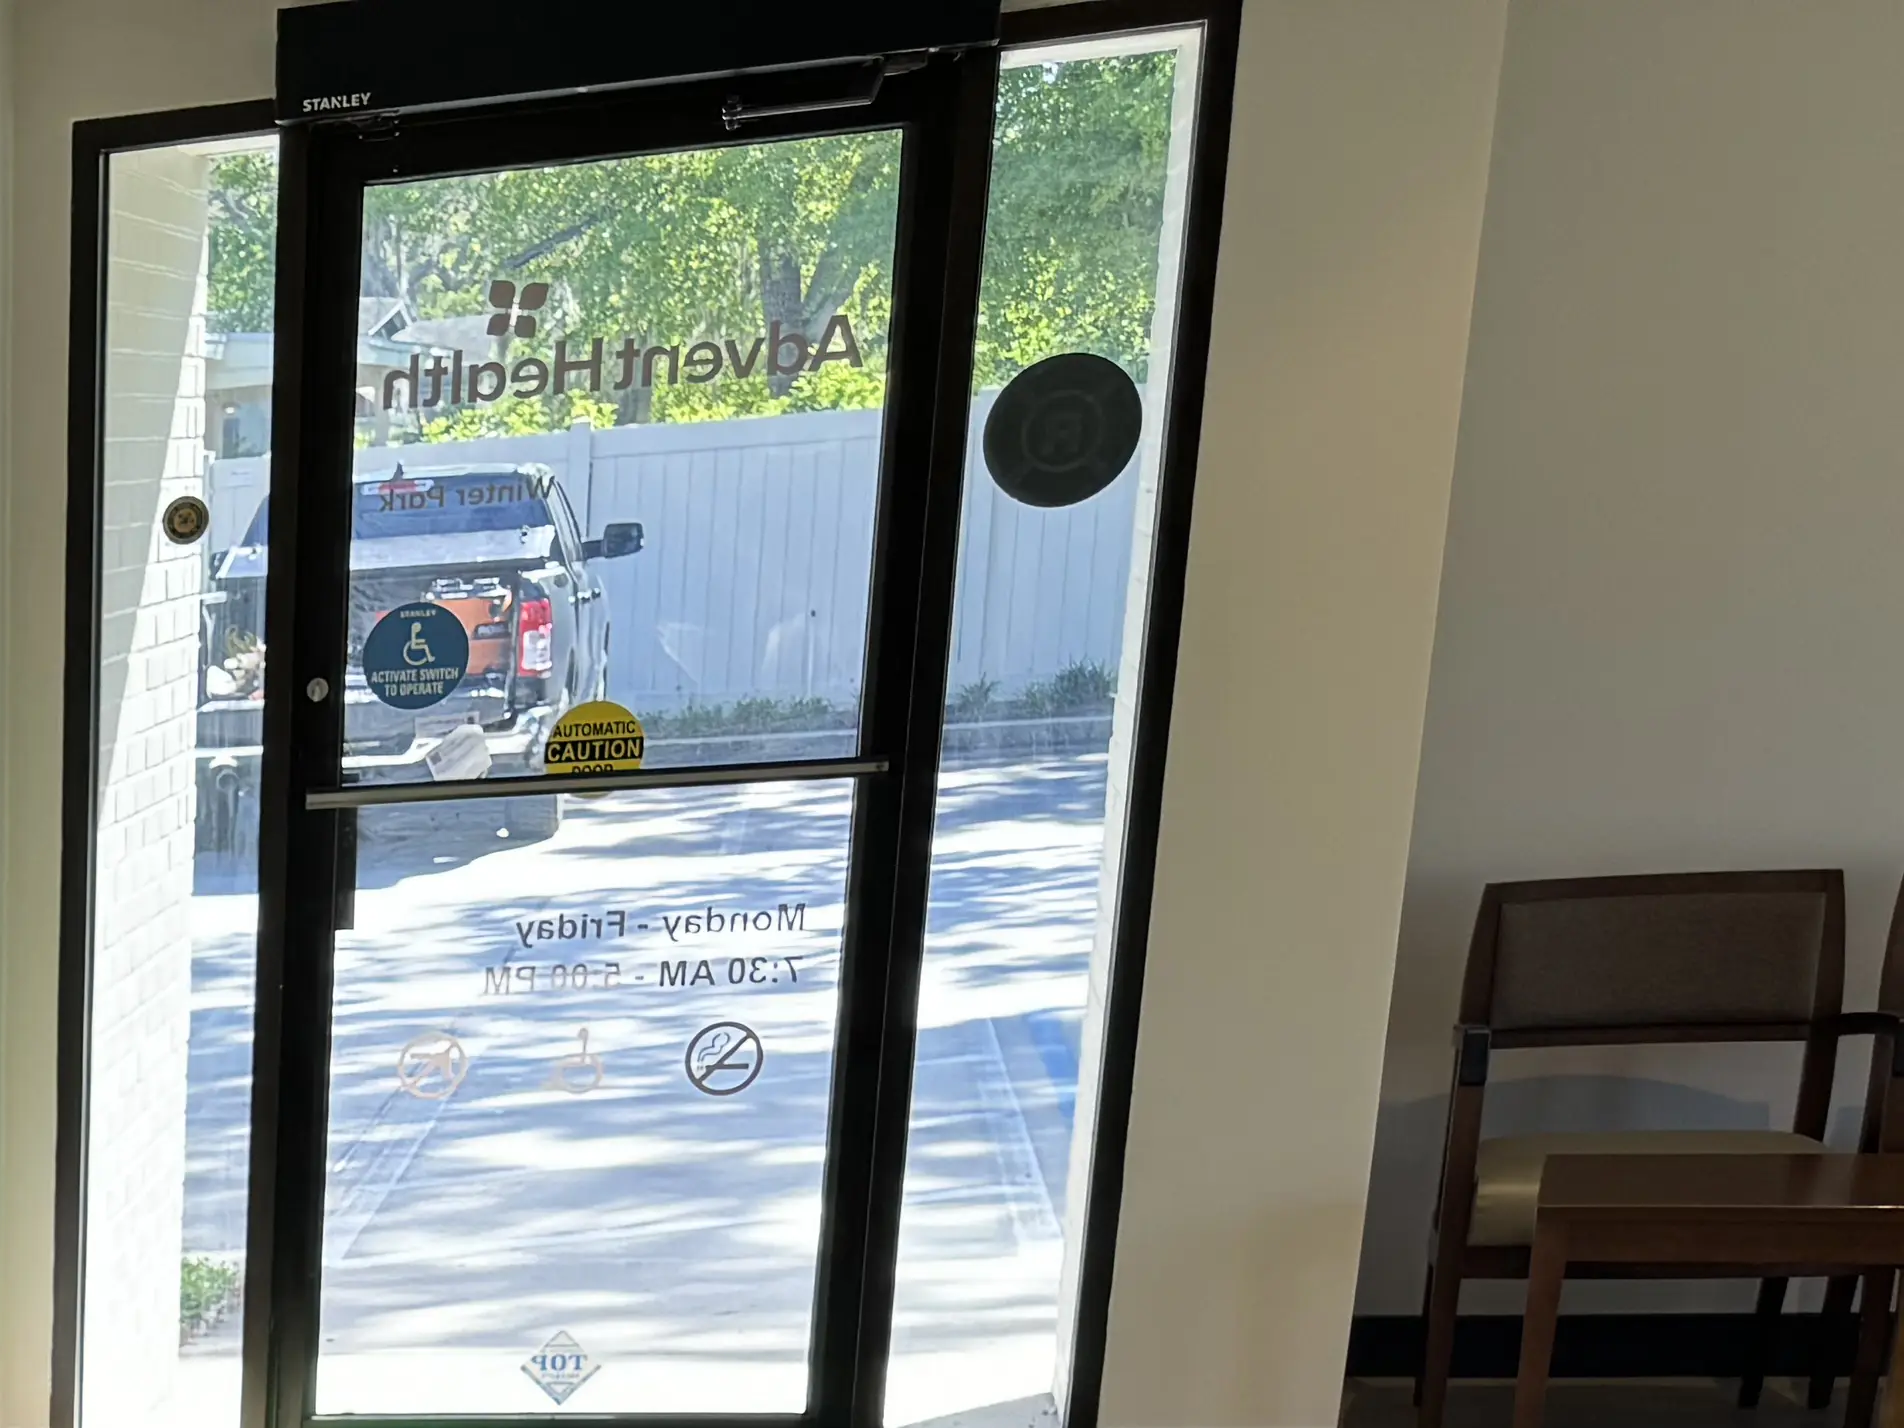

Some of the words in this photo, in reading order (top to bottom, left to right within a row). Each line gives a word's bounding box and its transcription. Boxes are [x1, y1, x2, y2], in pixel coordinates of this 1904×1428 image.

[302, 92, 372, 113] STANLEY
[371, 668, 418, 684] ACTIVATE
[419, 667, 459, 681] SWITCH
[384, 684, 397, 697] TO
[399, 681, 444, 696] OPERATE
[553, 720, 636, 738] AUTOMATIC
[547, 739, 641, 762] CAUTION
